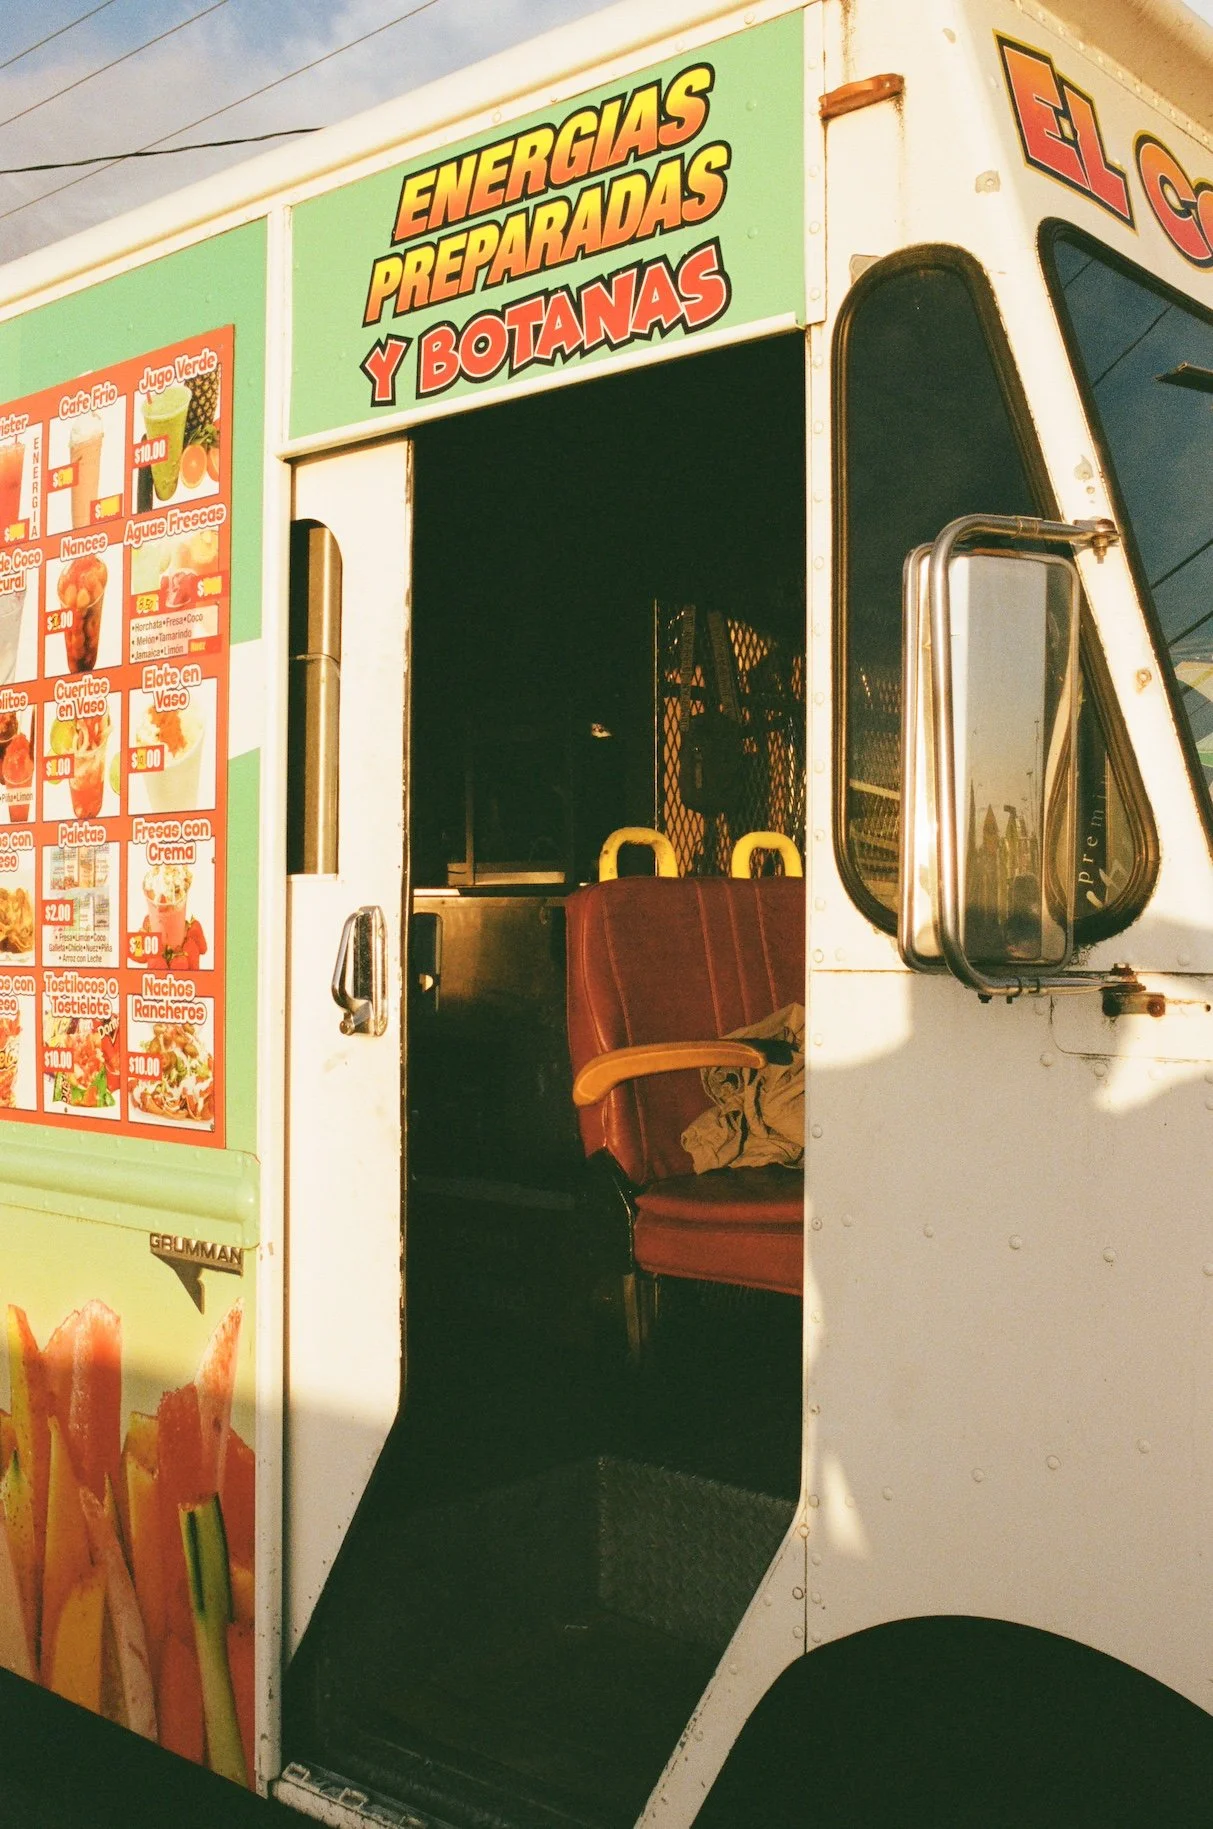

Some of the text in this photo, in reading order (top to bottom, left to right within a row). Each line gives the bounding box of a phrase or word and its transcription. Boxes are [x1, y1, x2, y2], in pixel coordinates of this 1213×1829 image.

[992, 28, 1139, 237] EL
[391, 62, 715, 247] ENERGIAS
[362, 140, 732, 327] PREPARADAS
[360, 236, 732, 407] Y BOTANAS
[140, 349, 216, 391] Jugo Verde
[60, 382, 117, 418] Cafe Frio
[134, 439, 166, 464] $10.00
[31, 437, 40, 537] ENERGIA
[125, 506, 225, 545] Aguas Frescas
[62, 536, 106, 558] Nances
[14, 550, 41, 569] Coco
[144, 667, 200, 689] Elote en
[56, 680, 108, 698] Cueritos
[58, 699, 105, 718] en Vaso
[156, 690, 188, 709] Vaso
[12, 833, 31, 845] con
[60, 825, 105, 843] Paletas
[134, 821, 209, 840] Fresas con
[149, 843, 194, 861] Crema
[45, 904, 71, 922] $2.00
[14, 979, 34, 991] con
[45, 975, 106, 994] Tostilocos
[144, 978, 193, 997] Nachos
[51, 996, 110, 1015] Tostielote
[134, 999, 204, 1021] Rancheros
[44, 1051, 72, 1069] $10.00
[129, 1057, 160, 1077] $10.00
[149, 1233, 244, 1264] GRUMMAN
